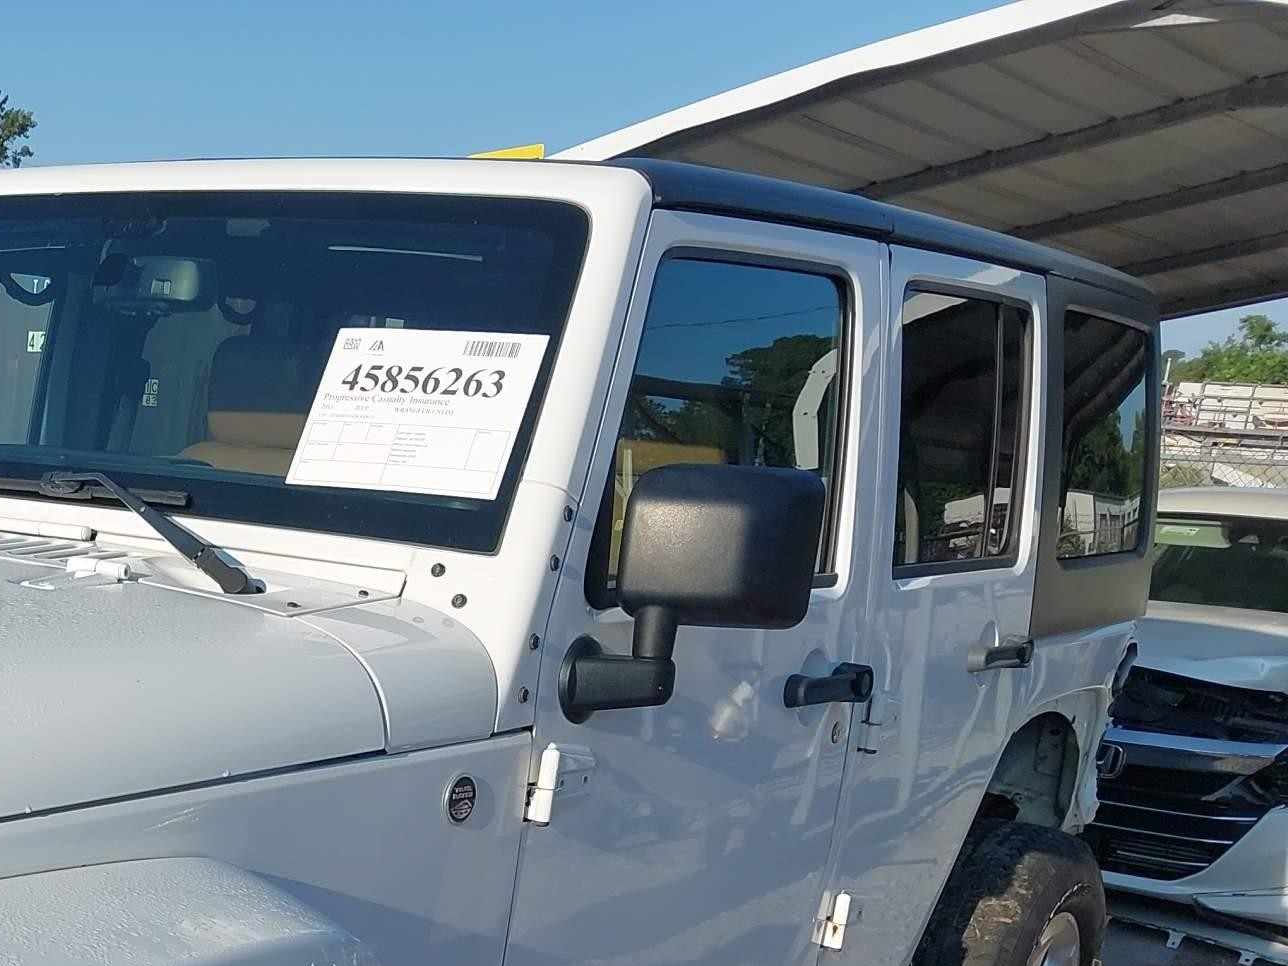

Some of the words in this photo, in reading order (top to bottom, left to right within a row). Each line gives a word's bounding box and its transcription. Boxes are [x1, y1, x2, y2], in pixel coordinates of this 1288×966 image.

[341, 363, 506, 399] 45856263
[323, 392, 370, 403] Progressive
[371, 393, 406, 406] Casualty
[409, 395, 450, 406] Insurance
